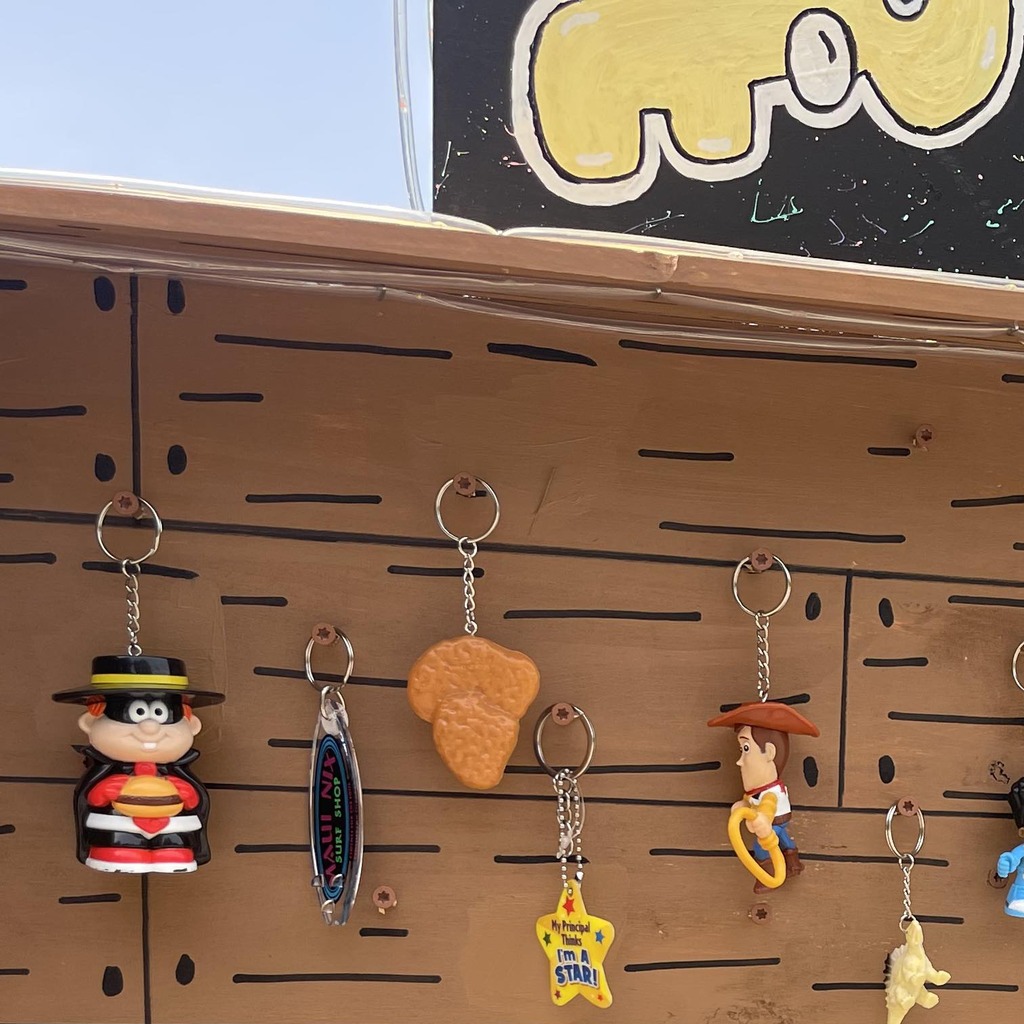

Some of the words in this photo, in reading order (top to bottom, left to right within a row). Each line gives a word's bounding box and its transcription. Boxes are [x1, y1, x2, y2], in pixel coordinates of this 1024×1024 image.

[321, 753, 335, 799] NIX
[333, 776, 342, 818] SHOP
[321, 815, 336, 887] MAUI
[334, 827, 343, 864] SURF
[551, 919, 561, 934] My
[562, 920, 591, 935] Principal
[561, 933, 582, 946] Thinks
[557, 948, 576, 963] I'm
[581, 949, 589, 964] A
[555, 963, 598, 987] STAR!
